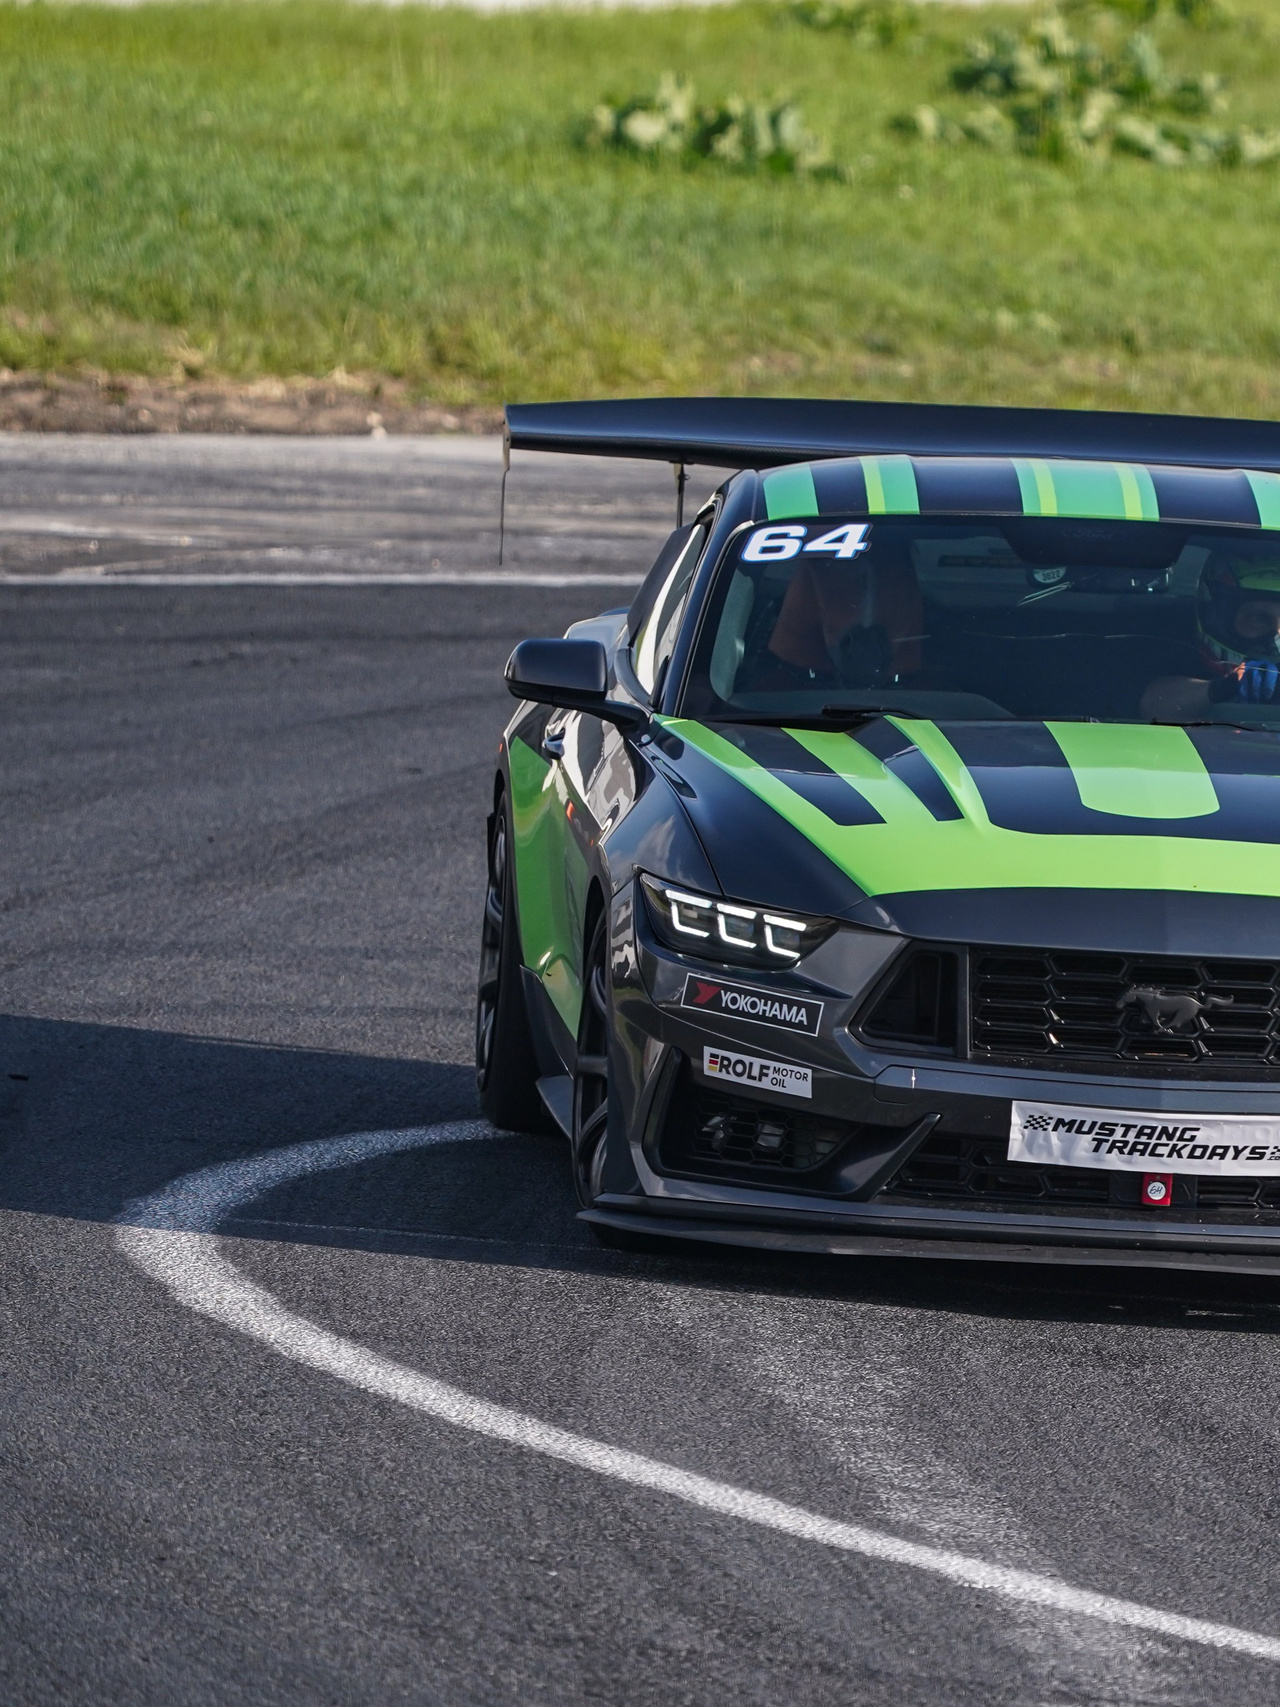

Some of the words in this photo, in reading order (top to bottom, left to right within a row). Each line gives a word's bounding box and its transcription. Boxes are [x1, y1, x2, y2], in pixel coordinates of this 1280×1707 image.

[741, 524, 869, 562] 64
[720, 989, 808, 1025] YOKOHAMA
[718, 1056, 770, 1082] ROLF
[772, 1066, 809, 1082] MOTOR
[770, 1076, 787, 1089] OIL
[1051, 1117, 1201, 1142] MUSTANG
[1092, 1137, 1270, 1161] TRACKDAYS
